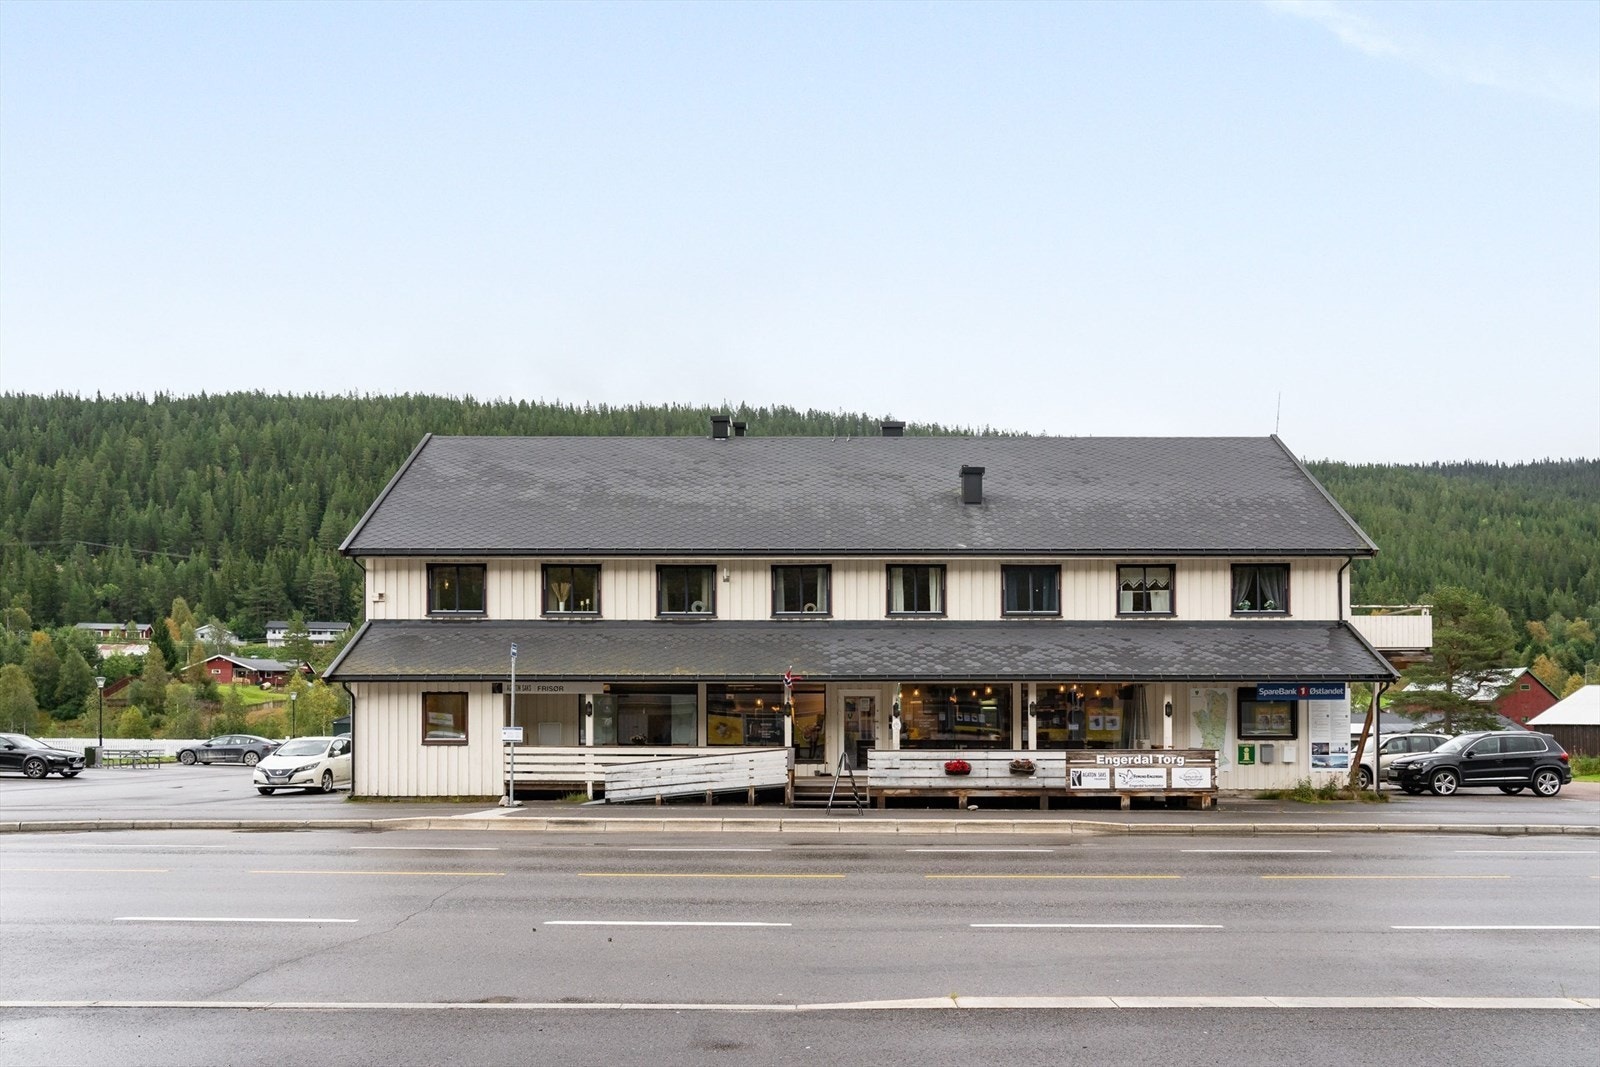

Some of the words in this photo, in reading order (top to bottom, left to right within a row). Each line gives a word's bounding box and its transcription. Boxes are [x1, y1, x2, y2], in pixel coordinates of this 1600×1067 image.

[1258, 687, 1297, 696] SpareBank
[1300, 687, 1306, 695] 1
[1309, 687, 1344, 695] Østlandet
[1096, 754, 1153, 767] Engerdal
[1156, 754, 1185, 767] Torg
